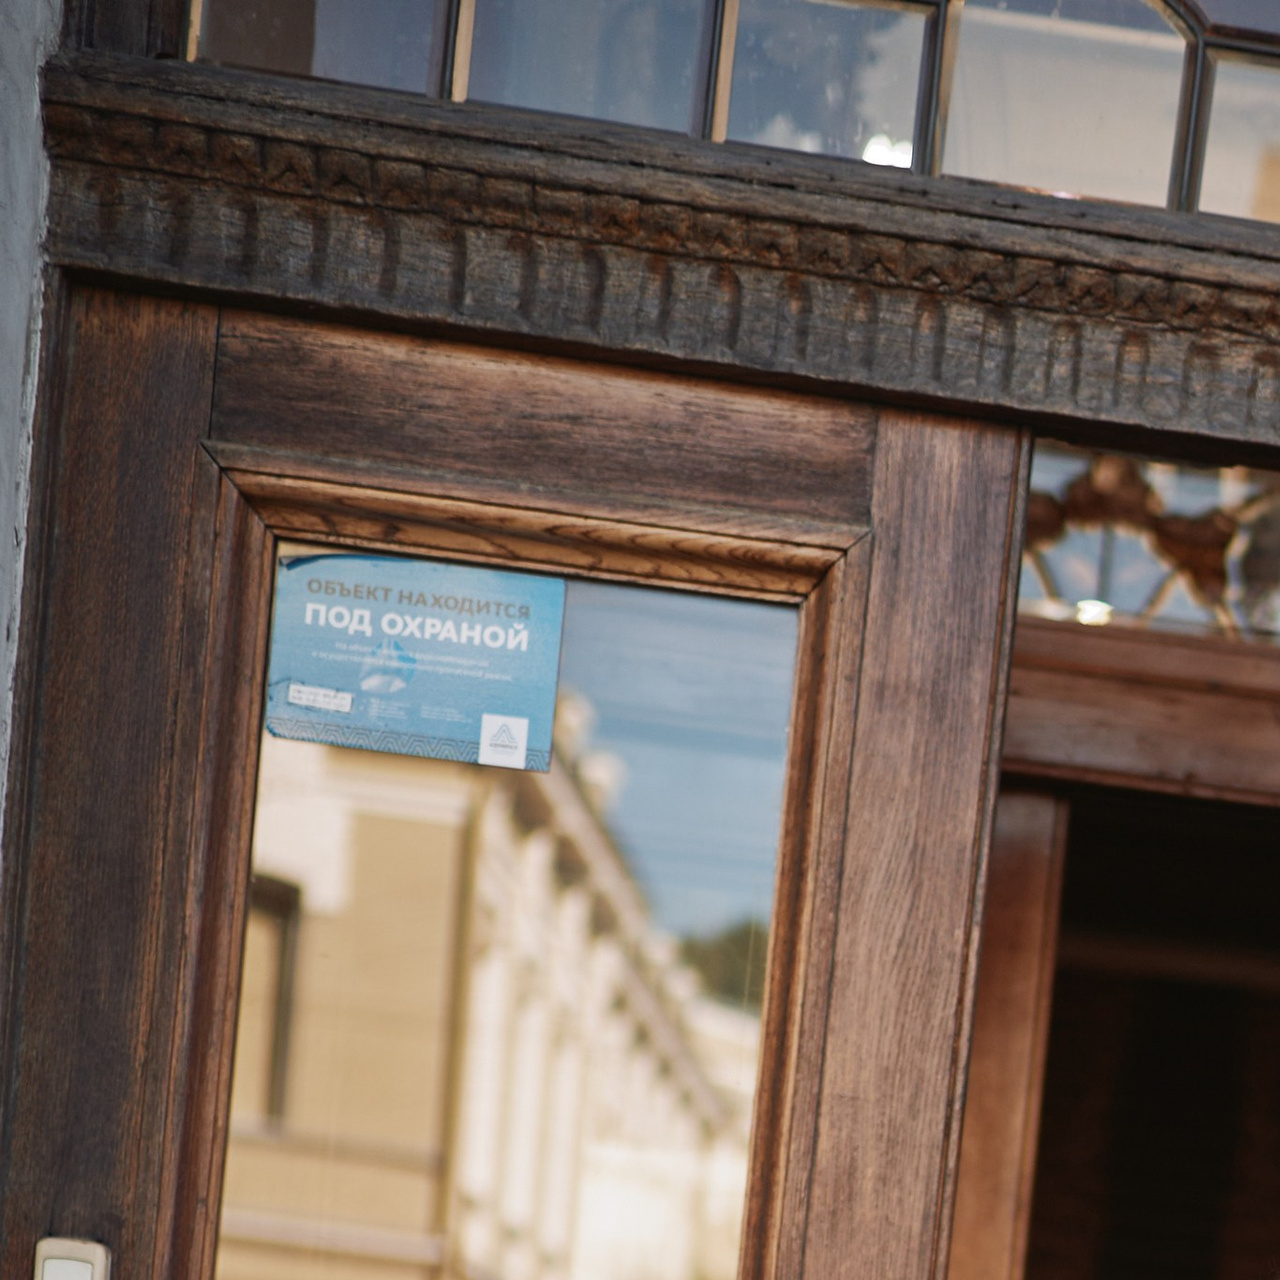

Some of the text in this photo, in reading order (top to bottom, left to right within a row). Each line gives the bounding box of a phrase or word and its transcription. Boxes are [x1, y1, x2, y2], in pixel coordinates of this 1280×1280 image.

[307, 578, 530, 620] ОБЪЕКТ НАХОДИТСЯ
[305, 603, 529, 652] ПОД ОХРАНОЙ
